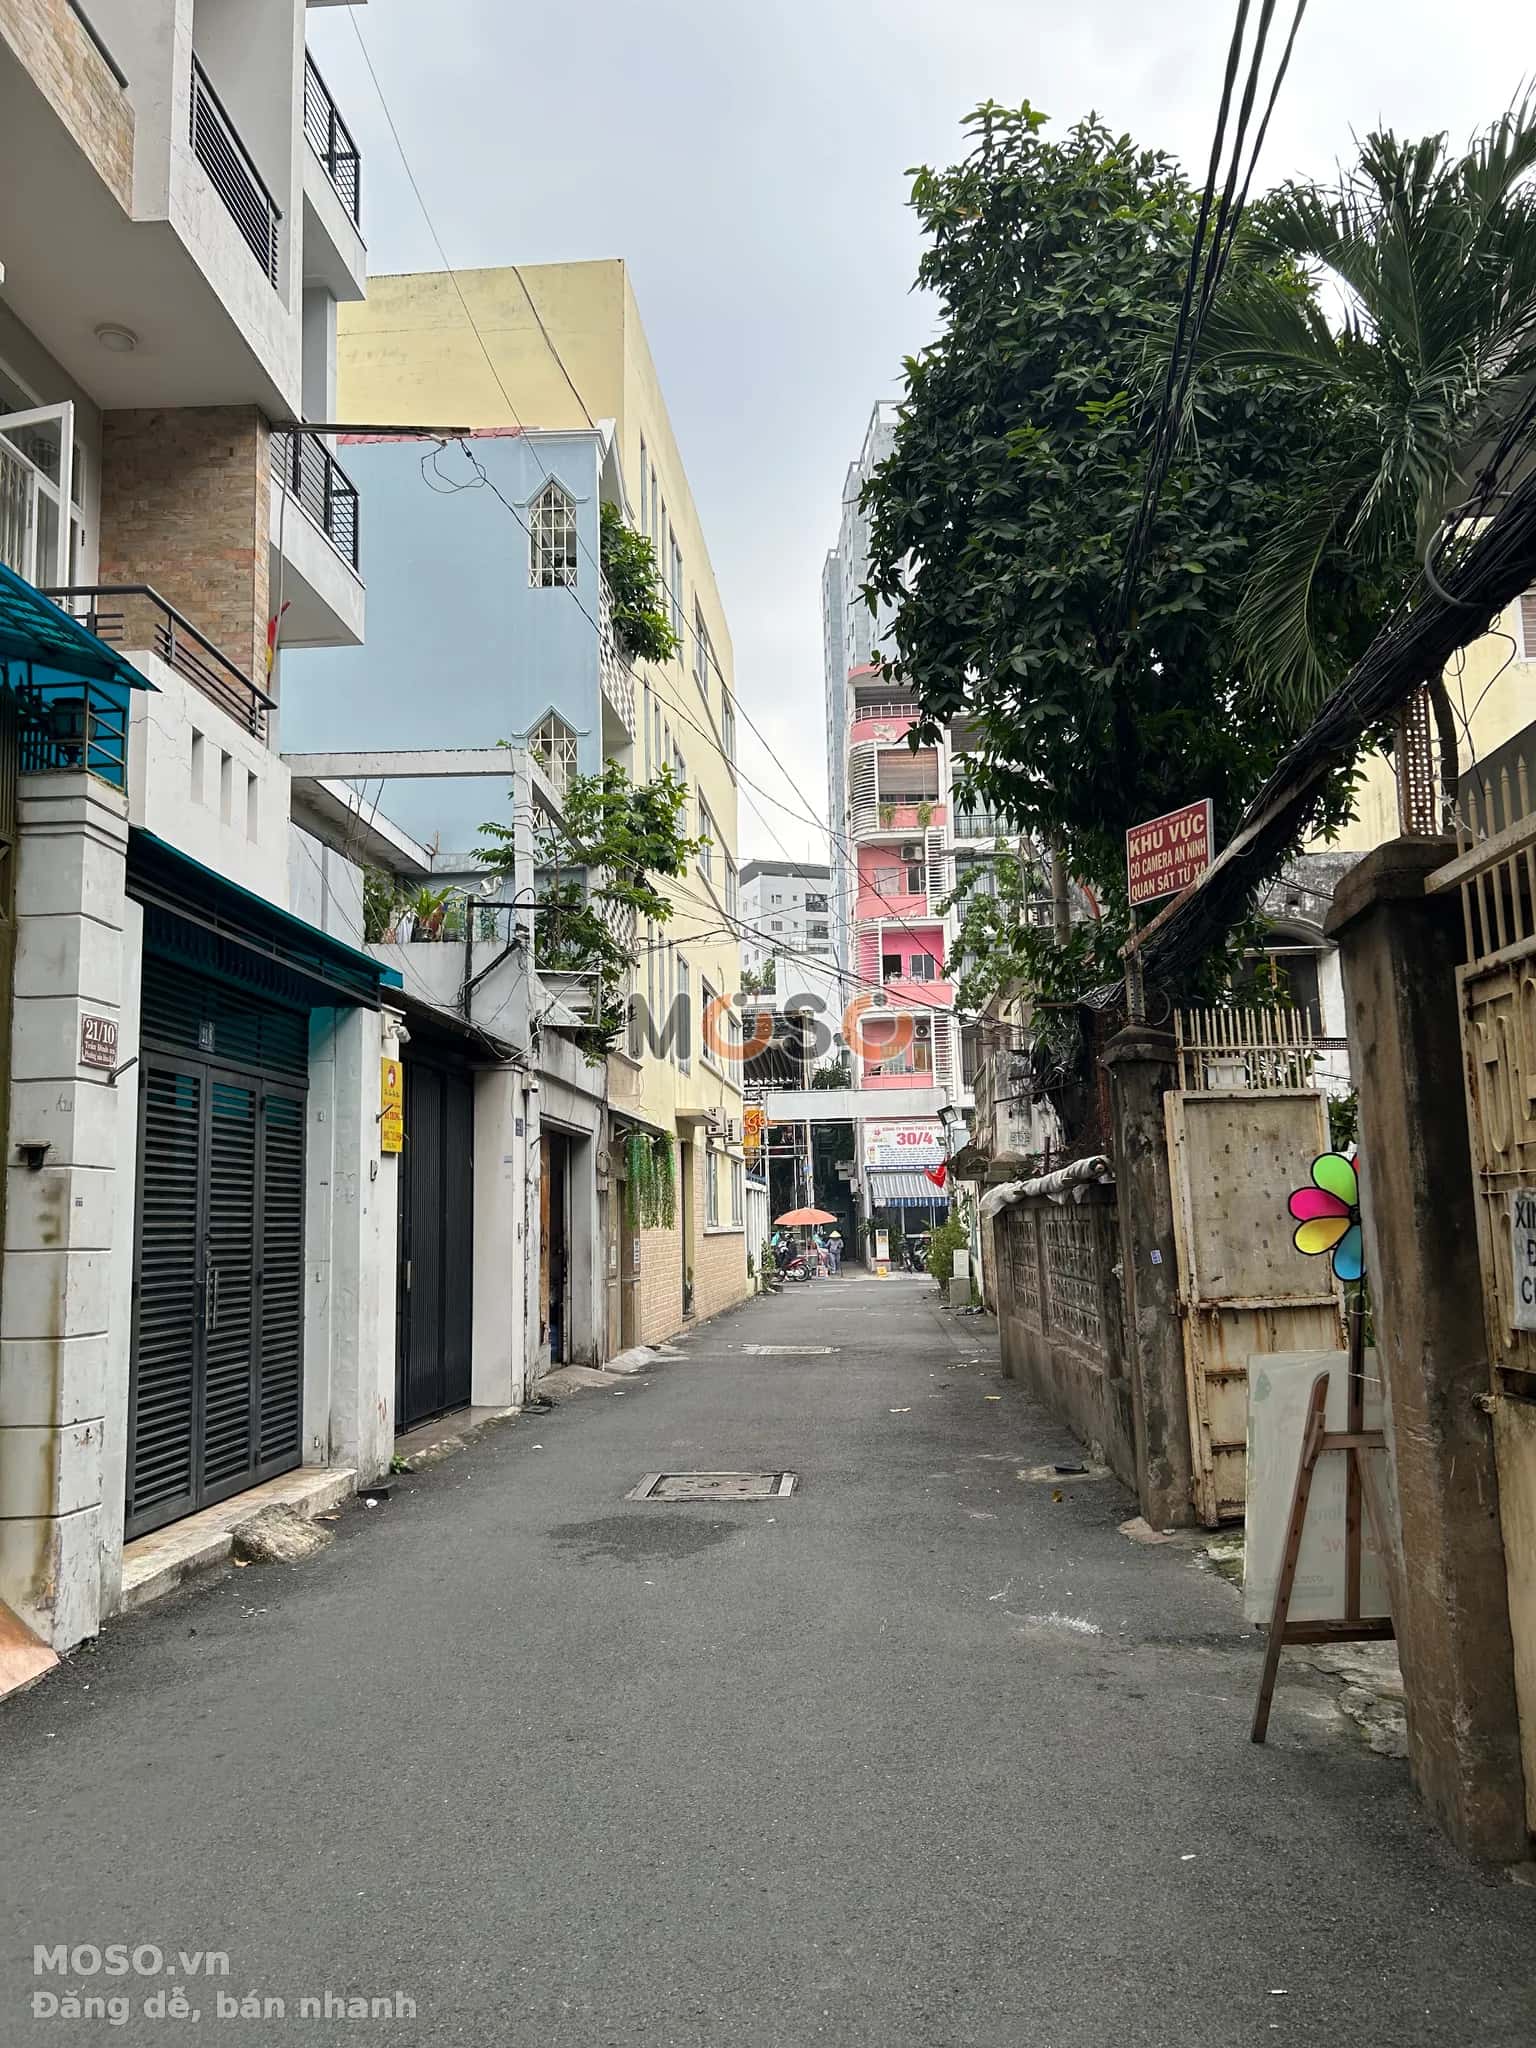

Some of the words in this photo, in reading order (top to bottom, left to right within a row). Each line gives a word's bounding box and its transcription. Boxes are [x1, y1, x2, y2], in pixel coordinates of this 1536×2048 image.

[1129, 829, 1164, 858] KHU
[1168, 813, 1205, 843] VỰC
[1130, 857, 1140, 879] CÓ
[1142, 849, 1173, 875] CAMERA
[1174, 844, 1185, 864] AN
[1187, 837, 1206, 859] NINH
[1131, 876, 1156, 901] QUAN
[1157, 868, 1175, 891] SÁT
[1178, 861, 1191, 885] TỪ
[86, 1019, 114, 1044] 21/10
[896, 1132, 933, 1146] 30/4
